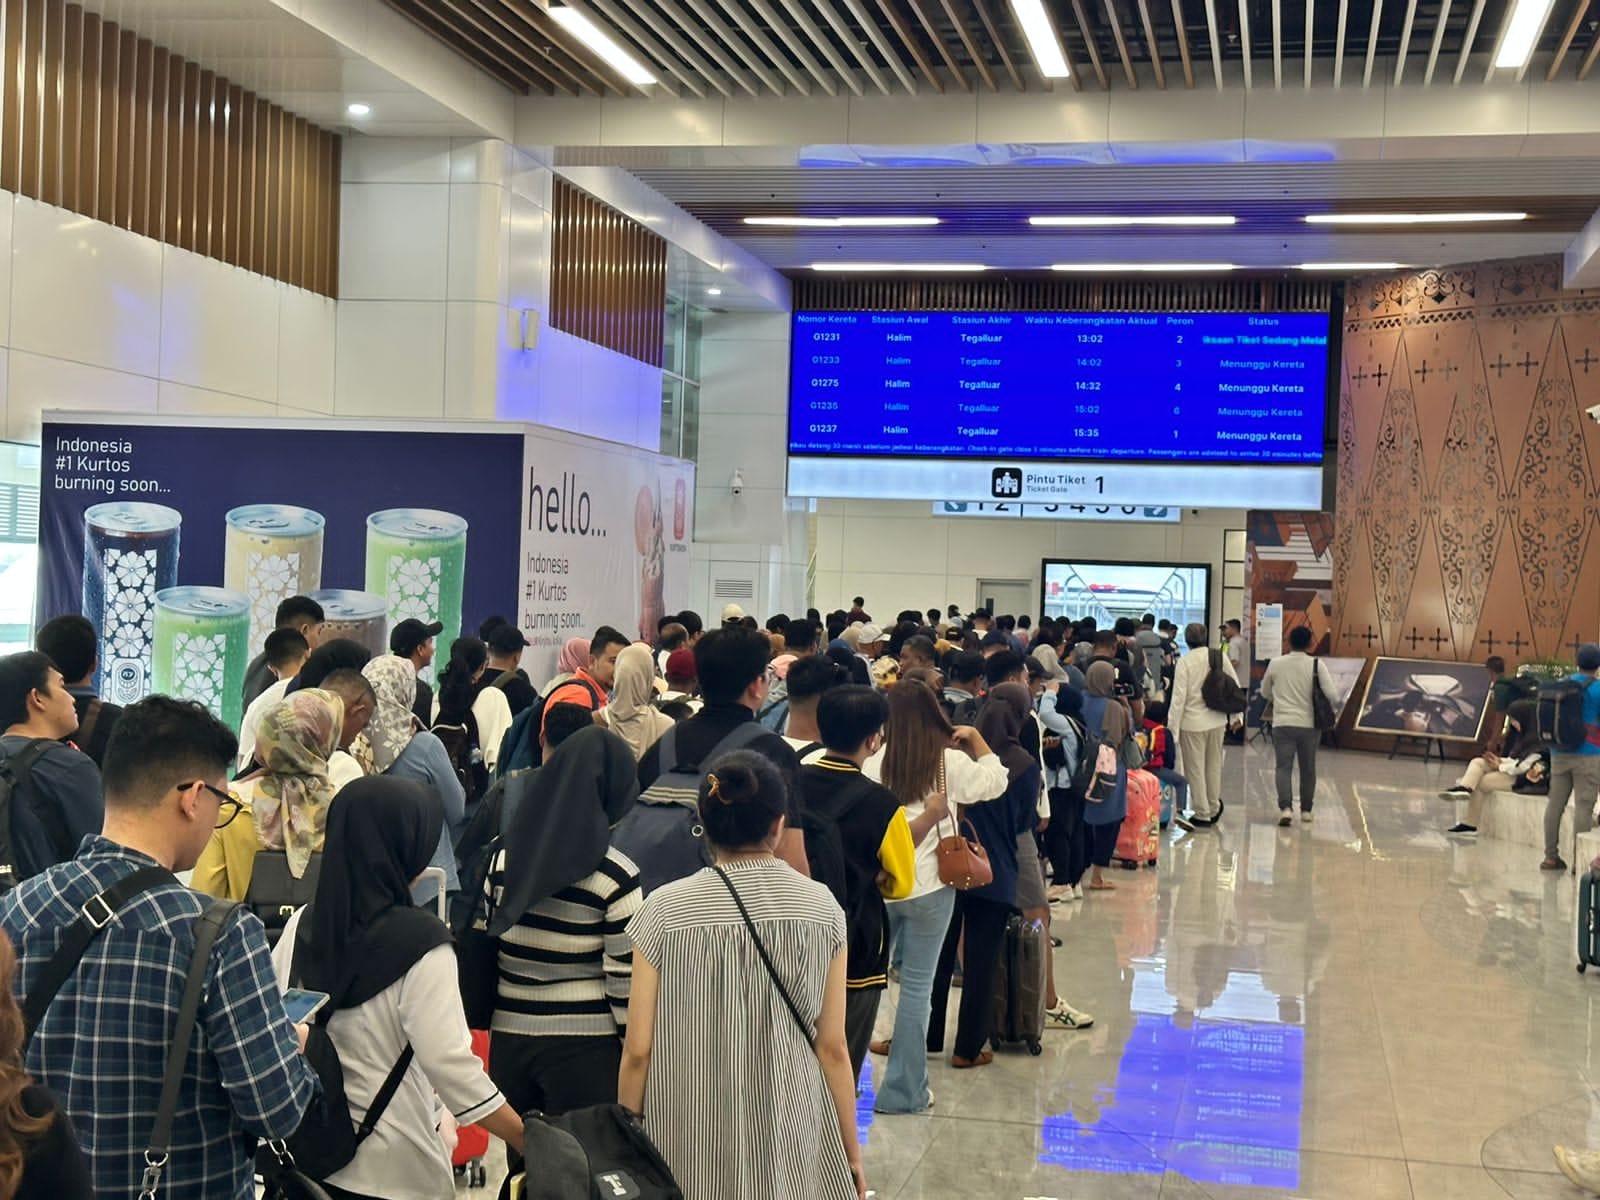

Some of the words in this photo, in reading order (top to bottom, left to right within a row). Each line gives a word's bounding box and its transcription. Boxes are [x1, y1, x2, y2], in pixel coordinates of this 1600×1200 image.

[797, 315, 827, 323] Nomor
[951, 316, 981, 324] Stasiun
[983, 316, 1013, 324] Akhir
[1055, 317, 1126, 326] Keberangkatan
[1166, 317, 1195, 325] Peron
[1248, 317, 1280, 325] Status
[960, 334, 1003, 344] Tegalluar
[1077, 335, 1104, 343] 13:02
[1176, 335, 1184, 344] 2
[959, 357, 1002, 367] Tegalluar
[1076, 358, 1103, 367] 14:02
[1175, 359, 1183, 368] 3
[1219, 360, 1269, 370] Menunggu
[884, 380, 911, 388] Halim
[959, 380, 1001, 390] Tegalluar
[1075, 382, 1102, 390] 14:32
[1174, 382, 1182, 392] 4
[1218, 384, 1269, 394] Menunggu
[1271, 384, 1305, 392] Kereta
[958, 404, 1000, 414] Tegalluar
[1074, 405, 1101, 413] 15:02
[1217, 408, 1270, 418] Menunggu
[1270, 408, 1304, 416] Kereta
[809, 424, 838, 432] G1237
[957, 427, 999, 437] Tegalluar
[1073, 428, 1100, 437] 15:35
[1173, 429, 1179, 439] 1
[1216, 432, 1269, 442] Menunggu
[1269, 432, 1303, 440] Kereta
[56, 436, 133, 453] Indonesia
[55, 456, 72, 471] #1
[77, 456, 131, 472] Kurtos
[55, 474, 115, 494] burning
[120, 480, 171, 493] soon...
[1026, 474, 1055, 484] Pintu
[1058, 475, 1086, 484] Tiket
[1095, 476, 1104, 494] 1
[528, 466, 607, 537] hello...
[527, 551, 569, 574] Indonesia
[526, 580, 536, 600] #1
[538, 580, 567, 601] Kurtos
[524, 607, 559, 634] burning
